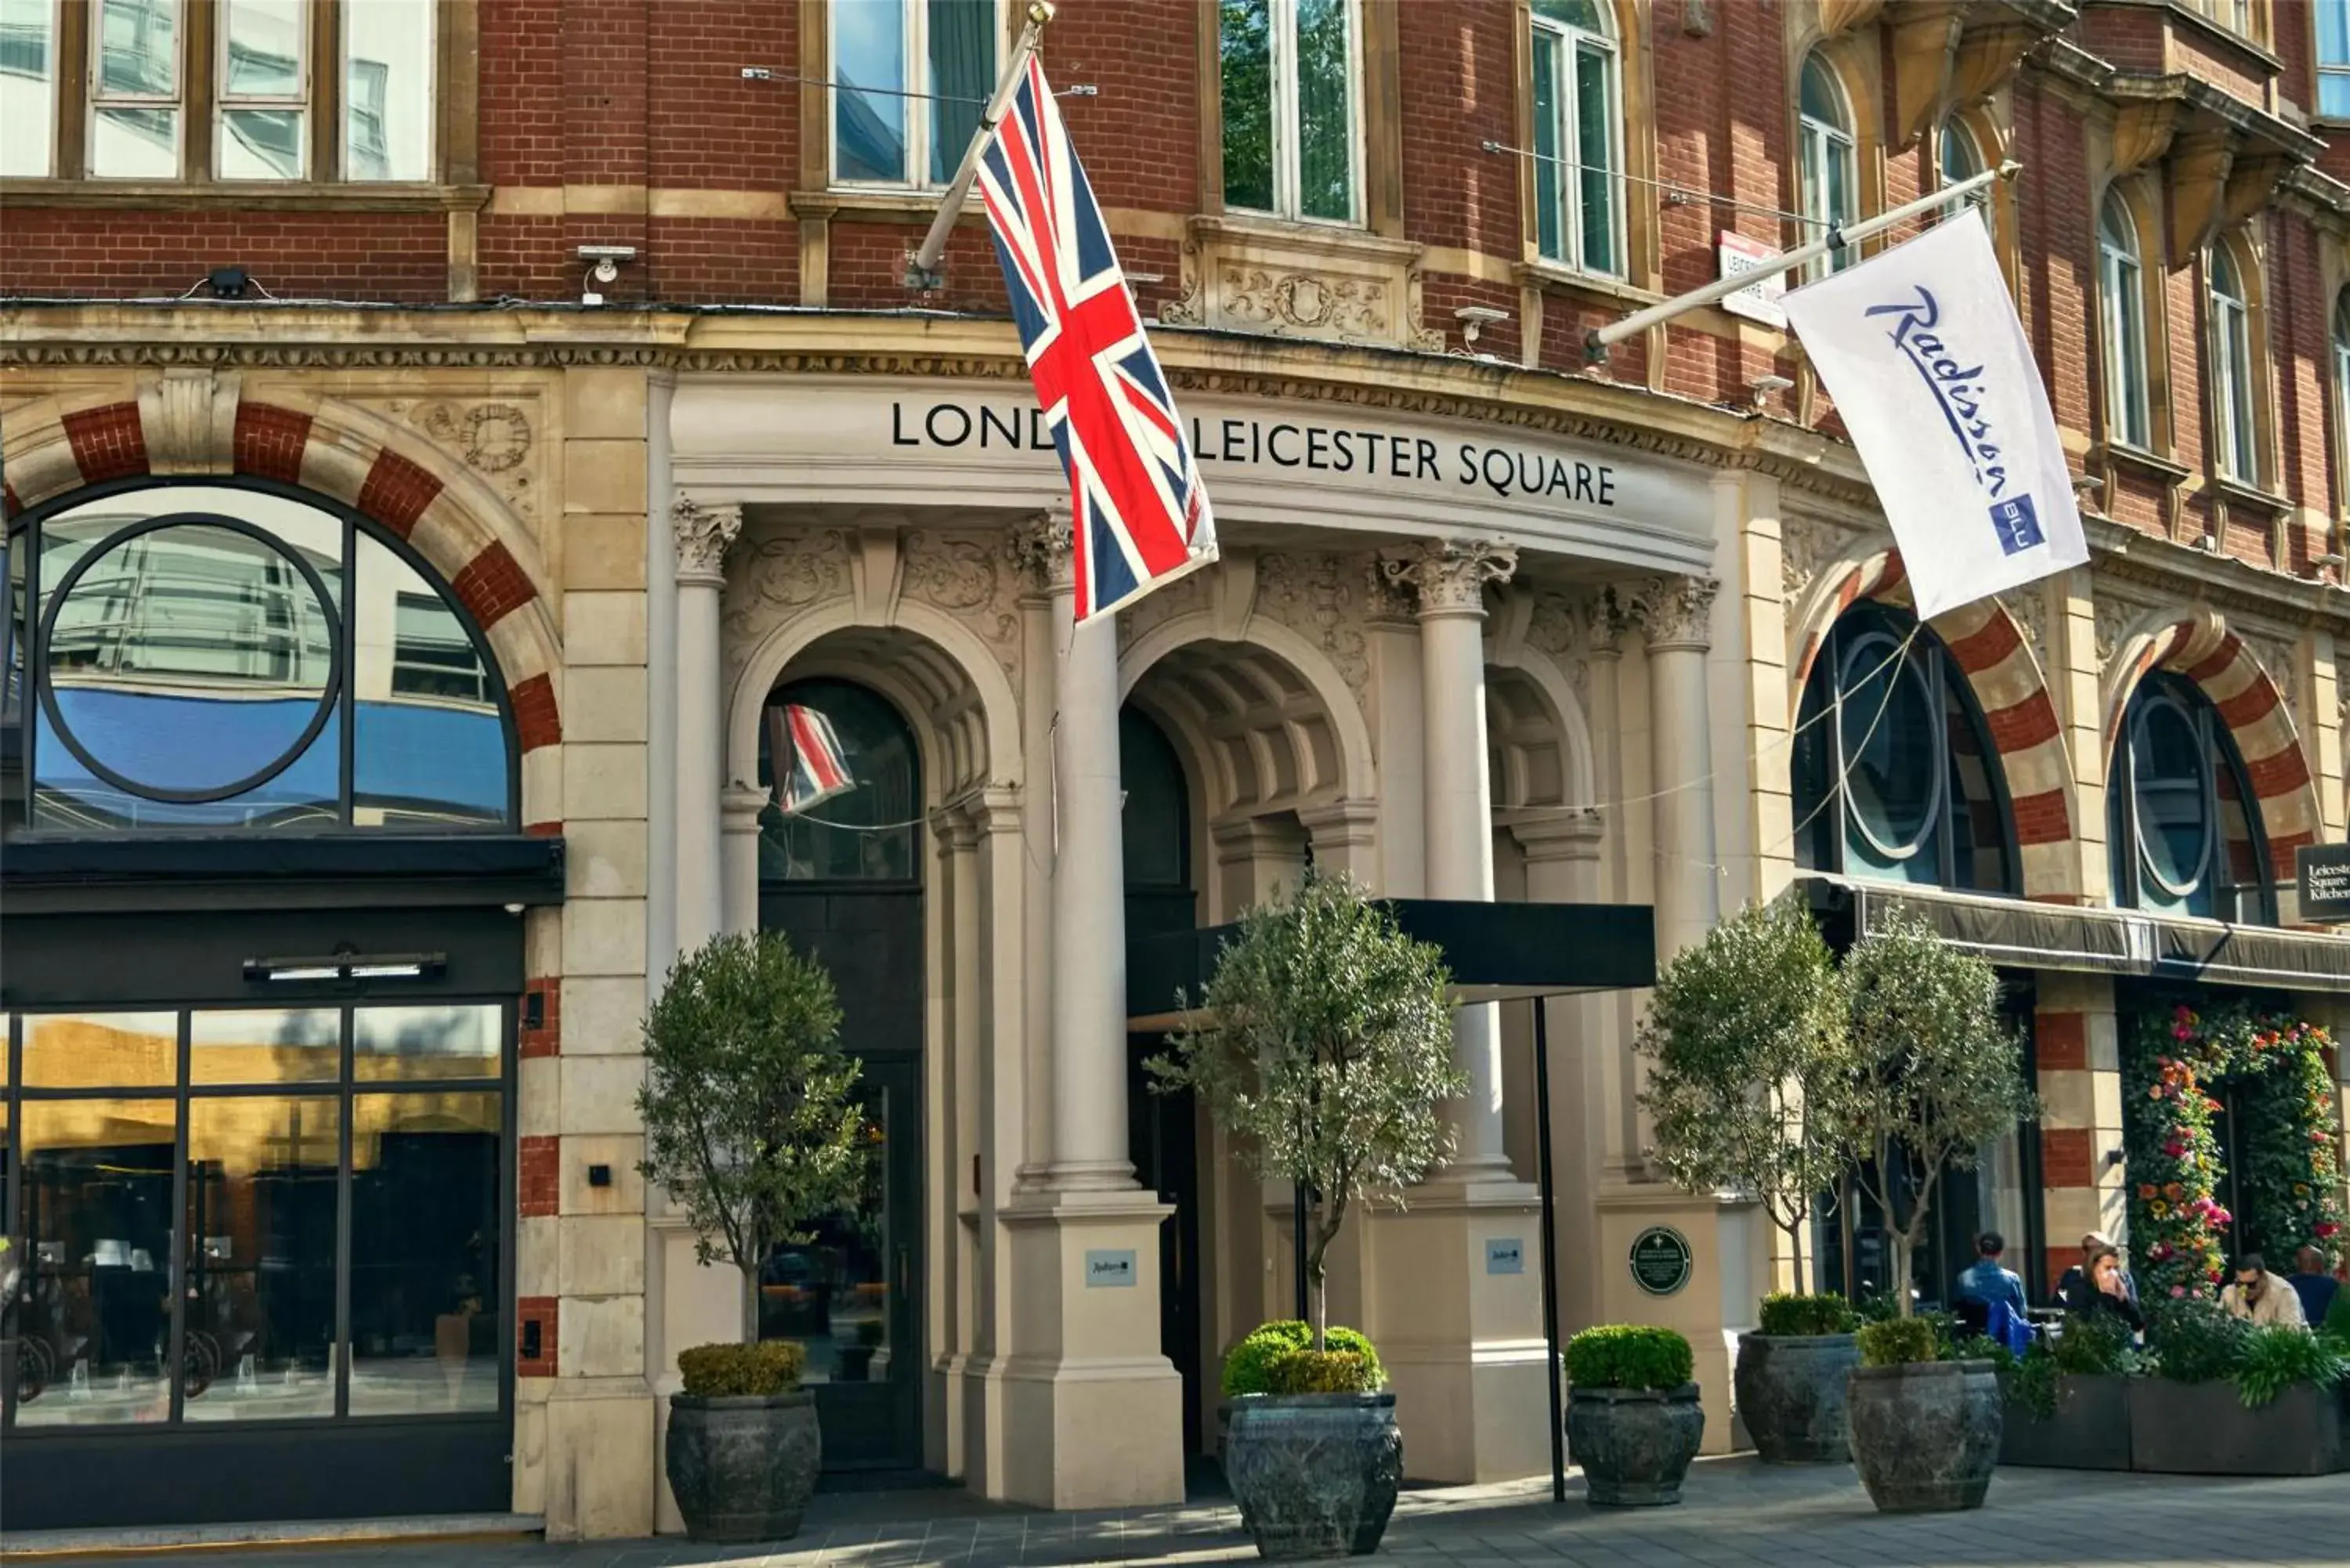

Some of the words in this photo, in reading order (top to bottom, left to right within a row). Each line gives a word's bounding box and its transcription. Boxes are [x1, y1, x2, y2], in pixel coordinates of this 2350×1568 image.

[1864, 284, 2007, 498] Radisson
[891, 403, 1056, 451] LOND
[1193, 417, 1441, 482] LEICESTER
[1459, 443, 1615, 507] SQUARE
[2003, 502, 2028, 548] BLU
[2308, 864, 2350, 877] Leiceste
[2308, 876, 2348, 889] Square
